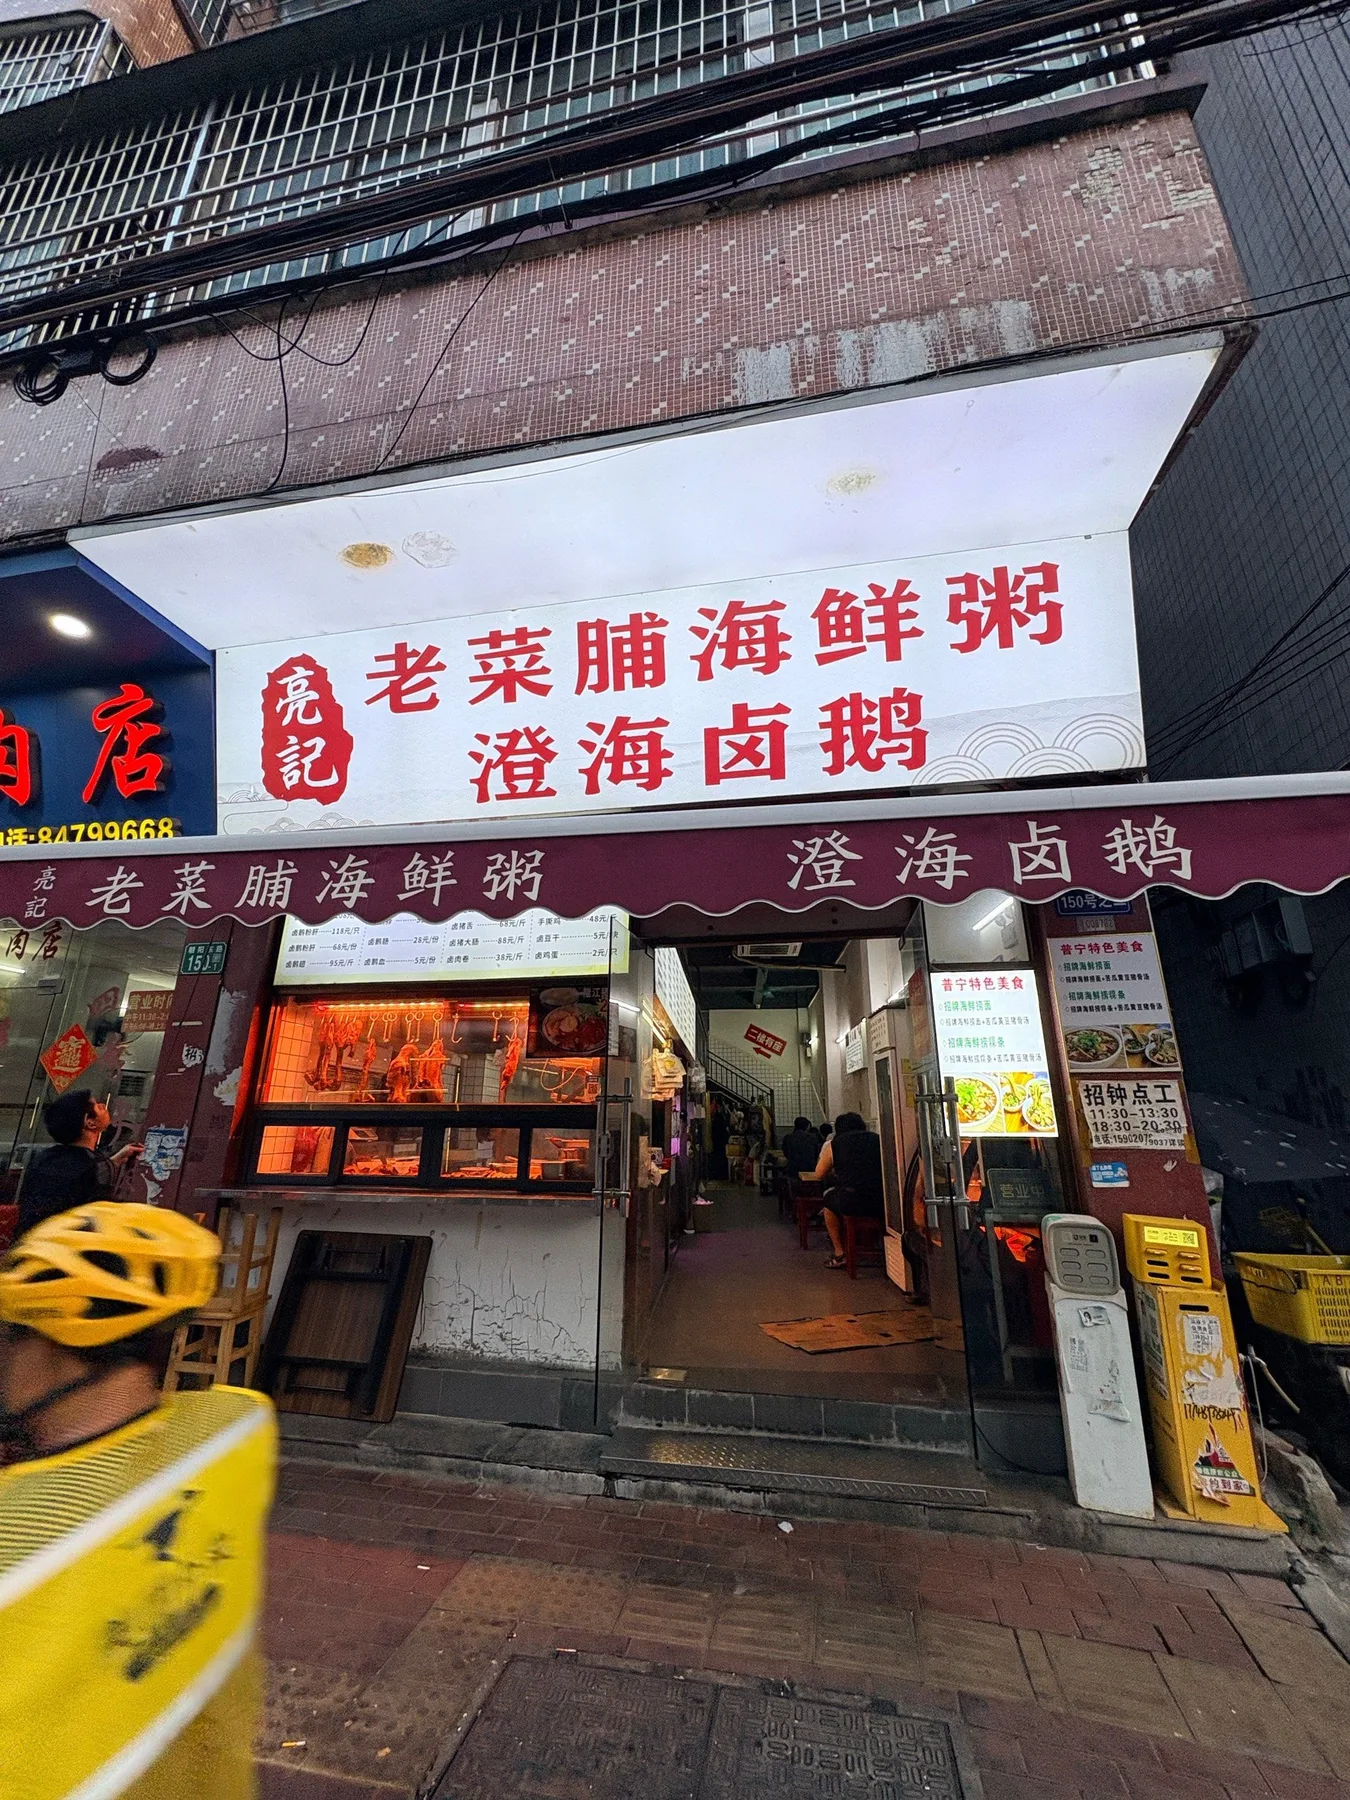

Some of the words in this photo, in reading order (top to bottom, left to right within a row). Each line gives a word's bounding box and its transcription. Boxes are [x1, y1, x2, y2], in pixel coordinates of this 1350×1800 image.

[366, 562, 1063, 714] 老菜脯海鲜粥
[468, 687, 929, 804] 澄海卤鹅
[786, 815, 1194, 892] 澄海卤鹅
[84, 850, 546, 916] 老菜脯海鲜粥
[497, 935, 525, 945] 88元/斤
[536, 934, 561, 943] 卤豆干
[534, 951, 559, 960] 卤鸡蛋
[1061, 940, 1144, 956] 普宁特色美食
[495, 952, 524, 962] 38元/斤
[942, 976, 1025, 991] 普宁特色美食
[1083, 1083, 1176, 1107] 招钟点工
[1089, 1108, 1179, 1120] 11:30-13:30
